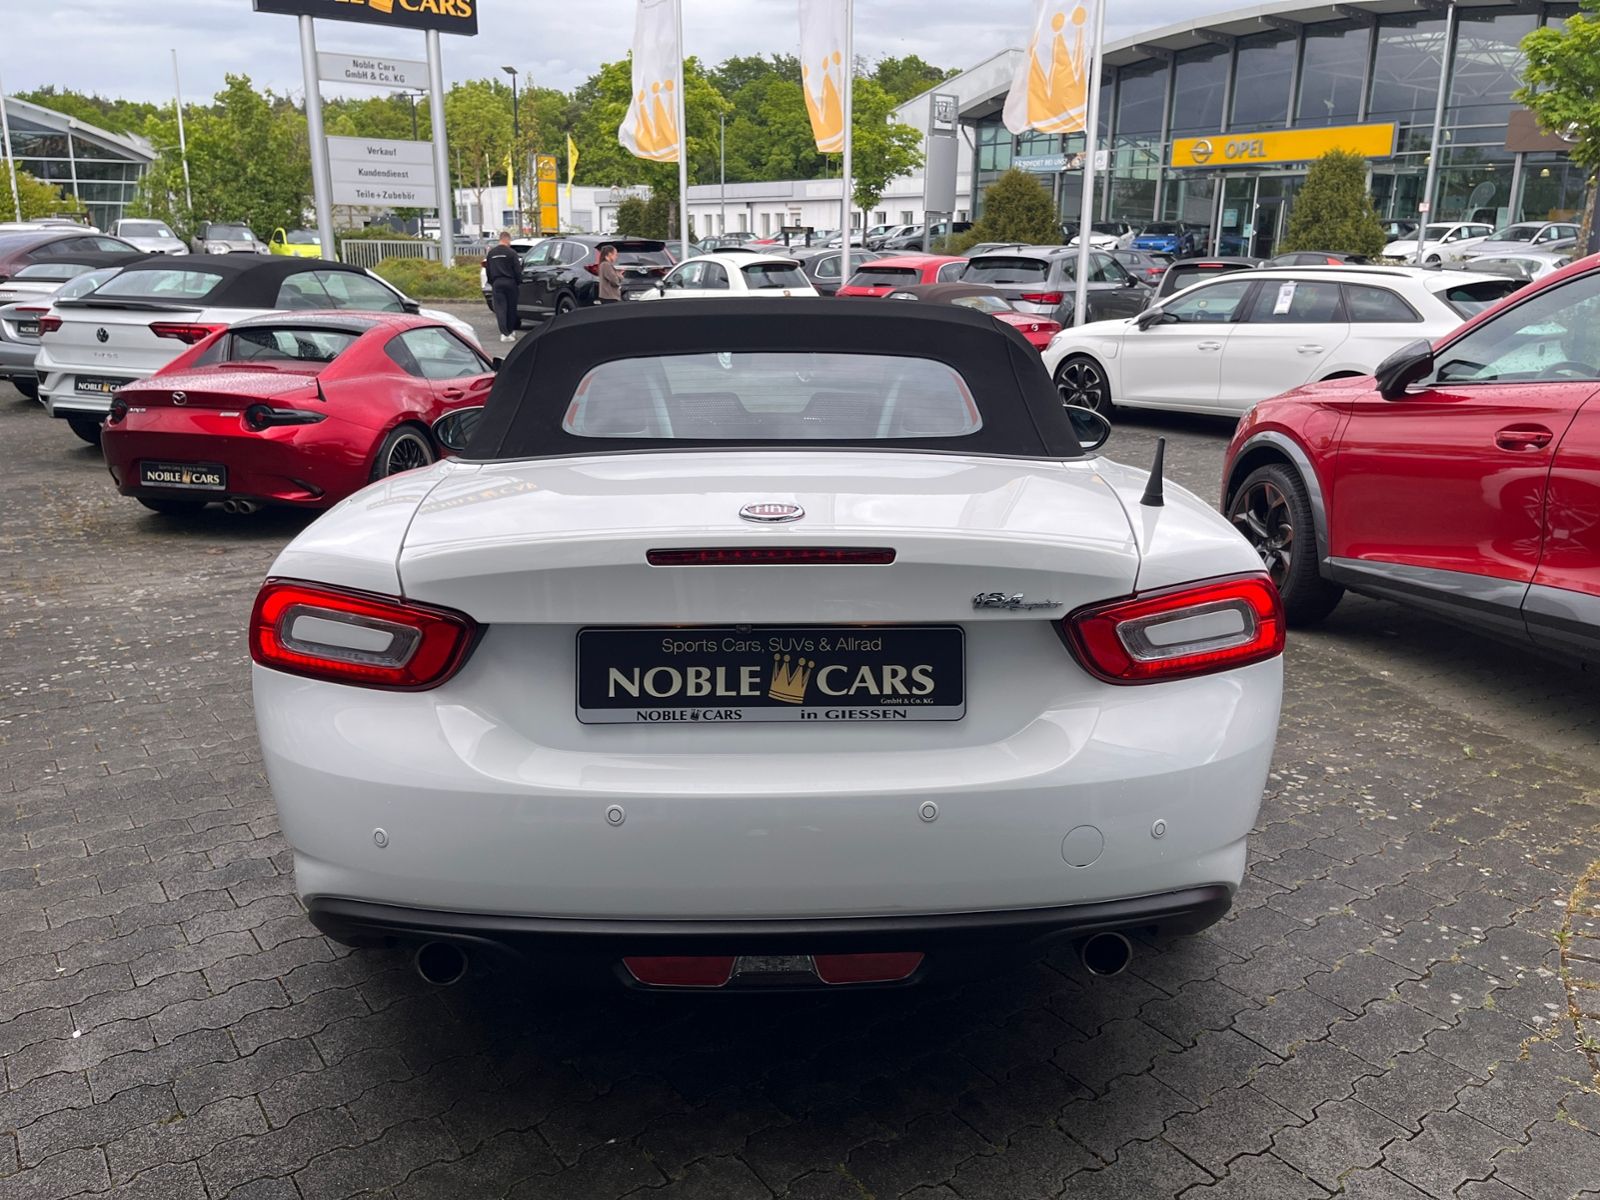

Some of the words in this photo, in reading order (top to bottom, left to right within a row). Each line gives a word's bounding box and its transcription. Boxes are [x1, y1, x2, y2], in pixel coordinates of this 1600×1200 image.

[352, 59, 375, 70] Noble
[378, 62, 396, 72] Cars
[345, 69, 368, 80] GmbH
[370, 72, 377, 81] &
[379, 72, 392, 82] Co.
[394, 73, 405, 83] KG
[367, 146, 397, 156] Verkauf
[1224, 139, 1267, 159] OPEL
[358, 168, 409, 178] Kundendienst
[78, 382, 102, 391] NOBLE
[147, 471, 181, 482] NOBLE
[192, 473, 220, 484] CARS
[662, 638, 718, 655] Sports
[721, 637, 765, 653] Cars,
[768, 637, 815, 652] SUVs
[818, 637, 831, 651] &
[835, 637, 882, 651] Allrad
[608, 666, 761, 697] NOBLE
[816, 664, 935, 696] CARS
[636, 710, 687, 721] NOBLE
[702, 709, 742, 720] CARS
[800, 709, 818, 719] in
[825, 709, 907, 719] GIESSEN
